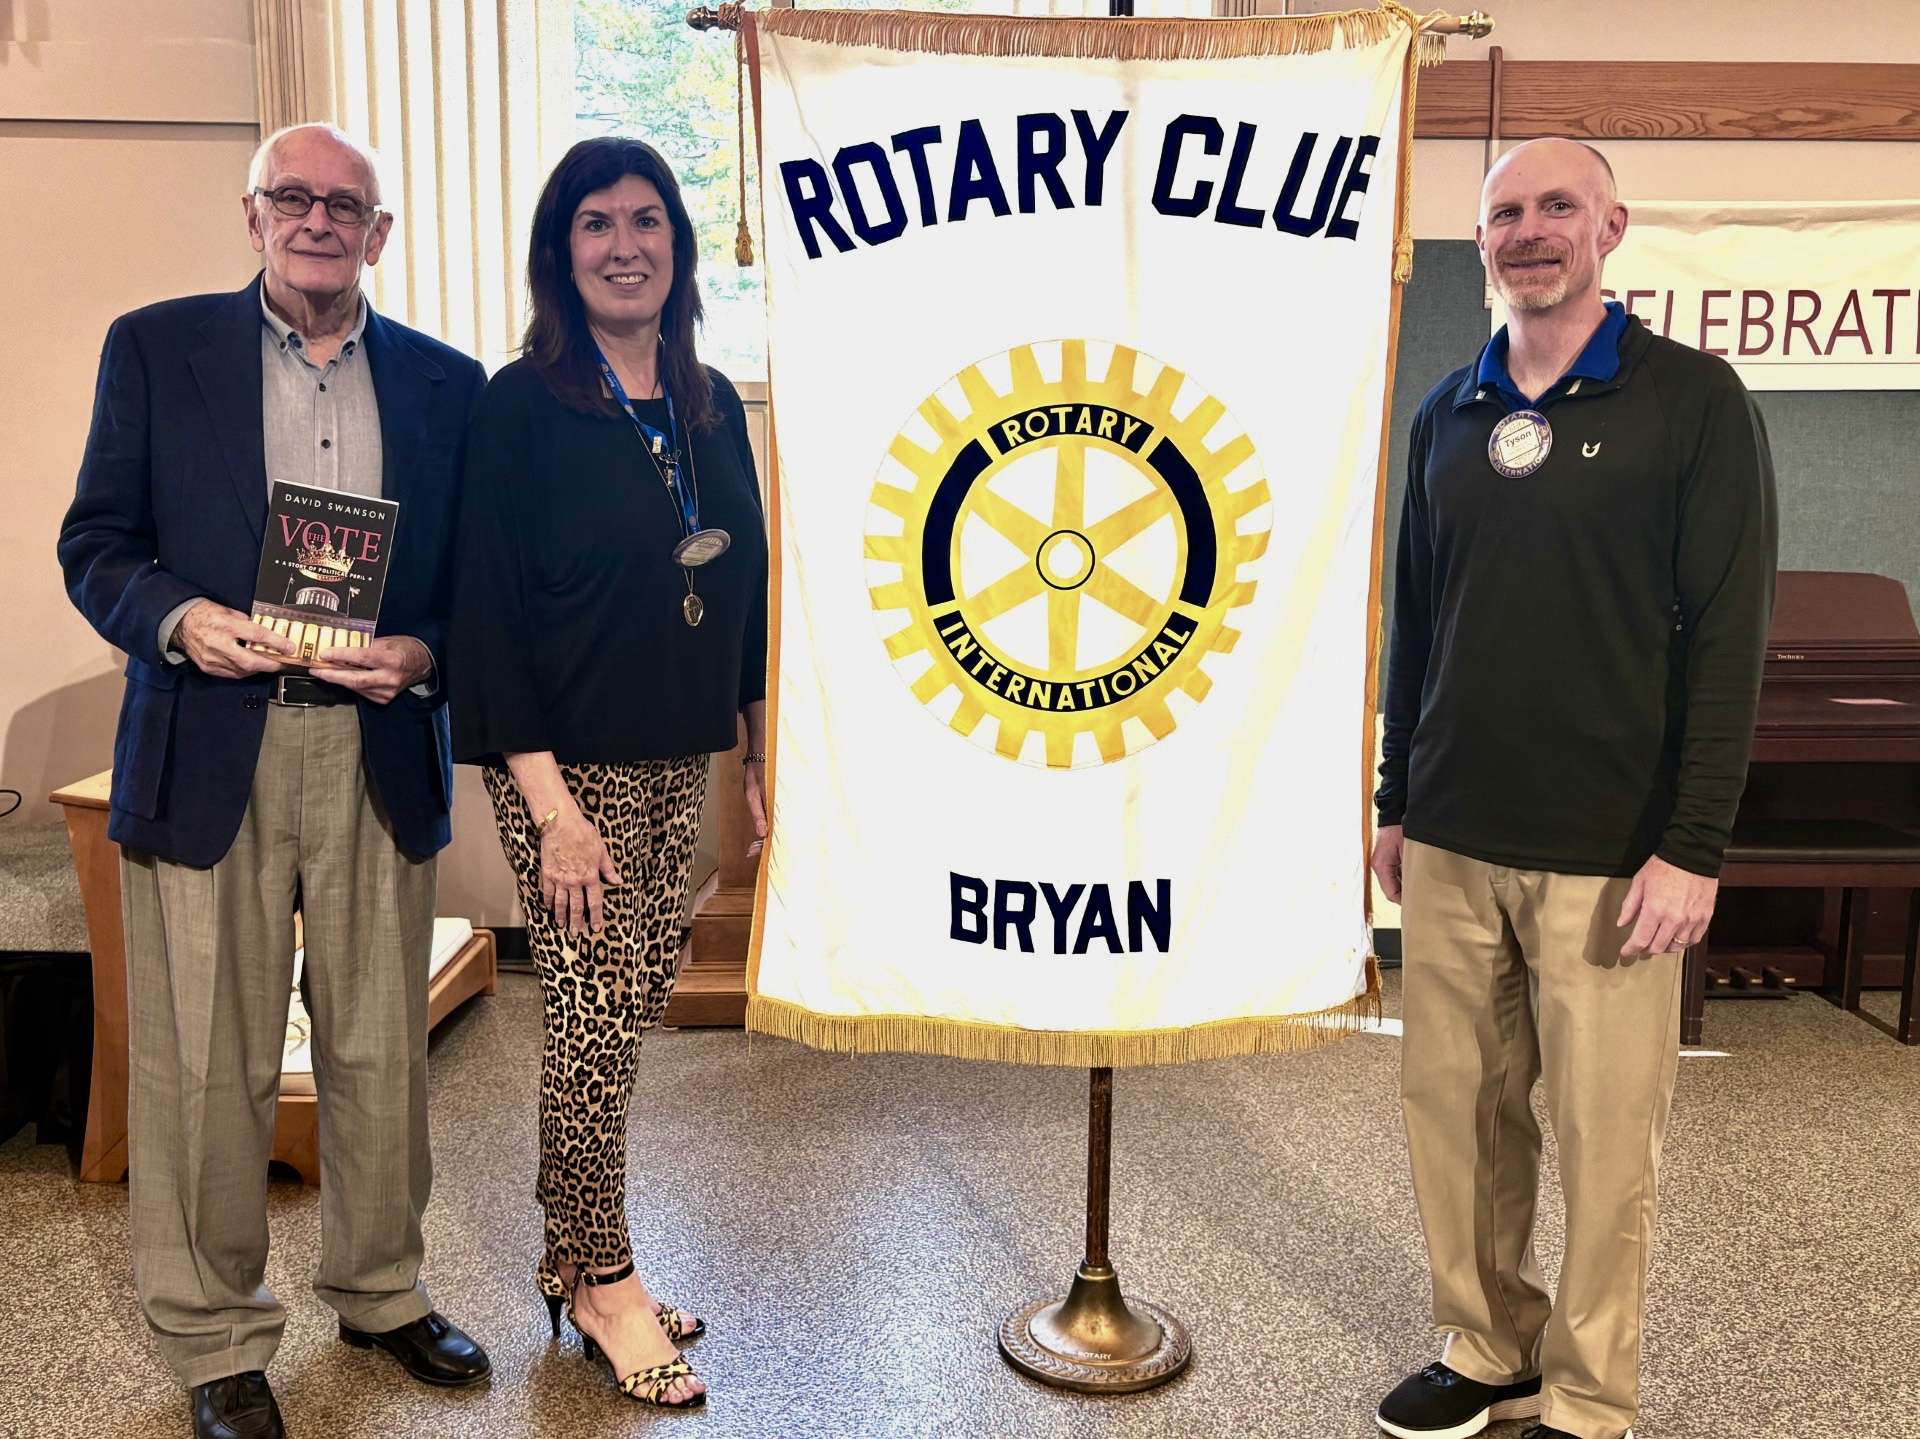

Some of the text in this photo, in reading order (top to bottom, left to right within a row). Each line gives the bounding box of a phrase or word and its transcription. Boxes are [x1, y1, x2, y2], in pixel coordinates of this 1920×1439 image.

[779, 109, 1129, 259] ROTARY
[1600, 288, 1920, 355] ELEBRAT
[1002, 406, 1143, 448] ROTARY
[1504, 431, 1532, 447] Tyson
[1493, 456, 1541, 477] INTERNATIO
[285, 494, 386, 520] DAVID SWANSON
[278, 514, 382, 563] VOTE
[308, 532, 326, 543] THE
[318, 567, 348, 577] POLITICAL
[349, 573, 366, 581] PERIL
[940, 621, 1192, 710] INTERNATIONAL
[950, 871, 1171, 955] BRYAN
